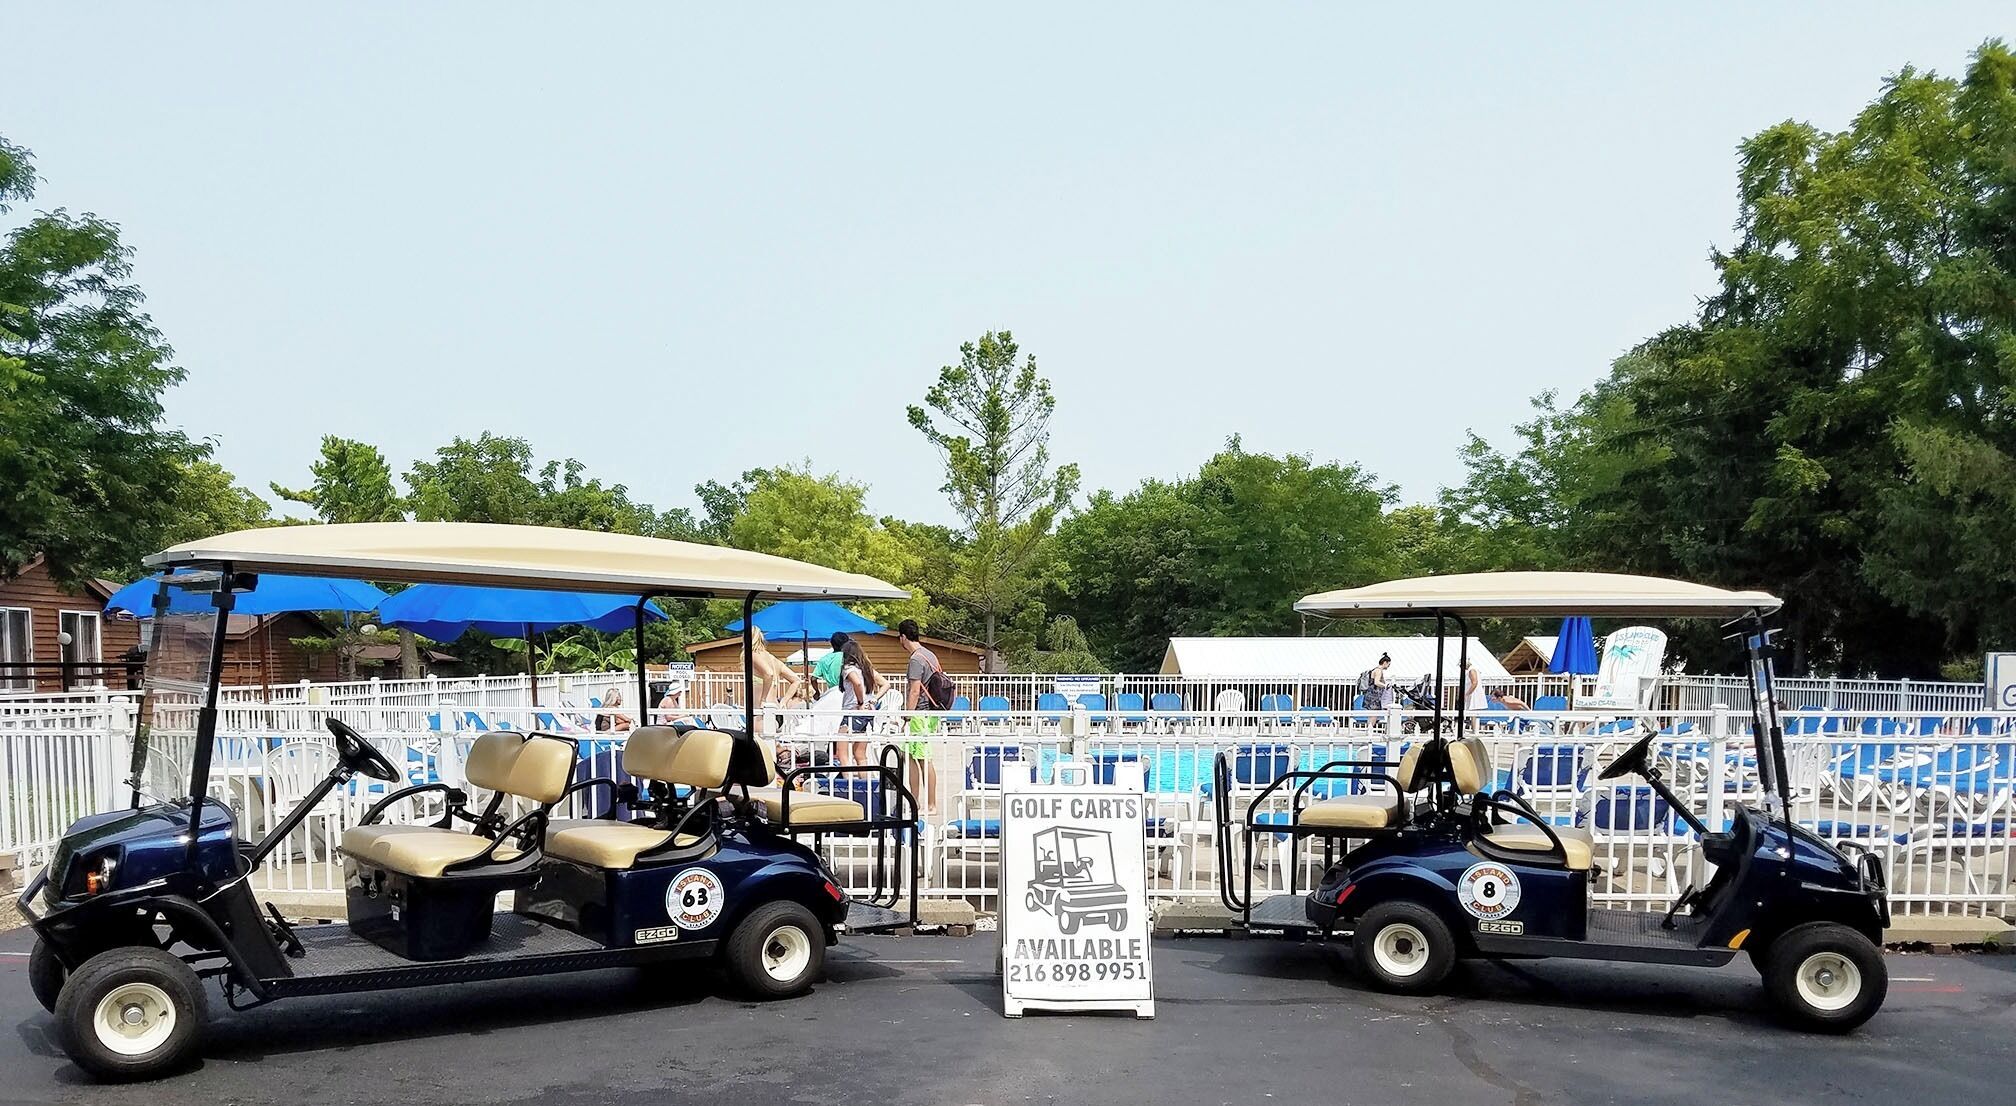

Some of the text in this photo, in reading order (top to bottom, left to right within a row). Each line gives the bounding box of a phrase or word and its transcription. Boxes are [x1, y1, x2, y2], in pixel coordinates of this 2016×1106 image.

[1010, 798, 1137, 819] GOLF CARTS
[676, 875, 713, 891] ISLAND
[1470, 869, 1510, 886] ISLAND
[682, 887, 709, 908] 63
[1483, 881, 1496, 898] 8
[682, 910, 709, 922] CLUB
[1473, 902, 1503, 913] CLUB
[1014, 938, 1141, 960] AVAILABLE
[1010, 962, 1147, 982] 216 898 9951
